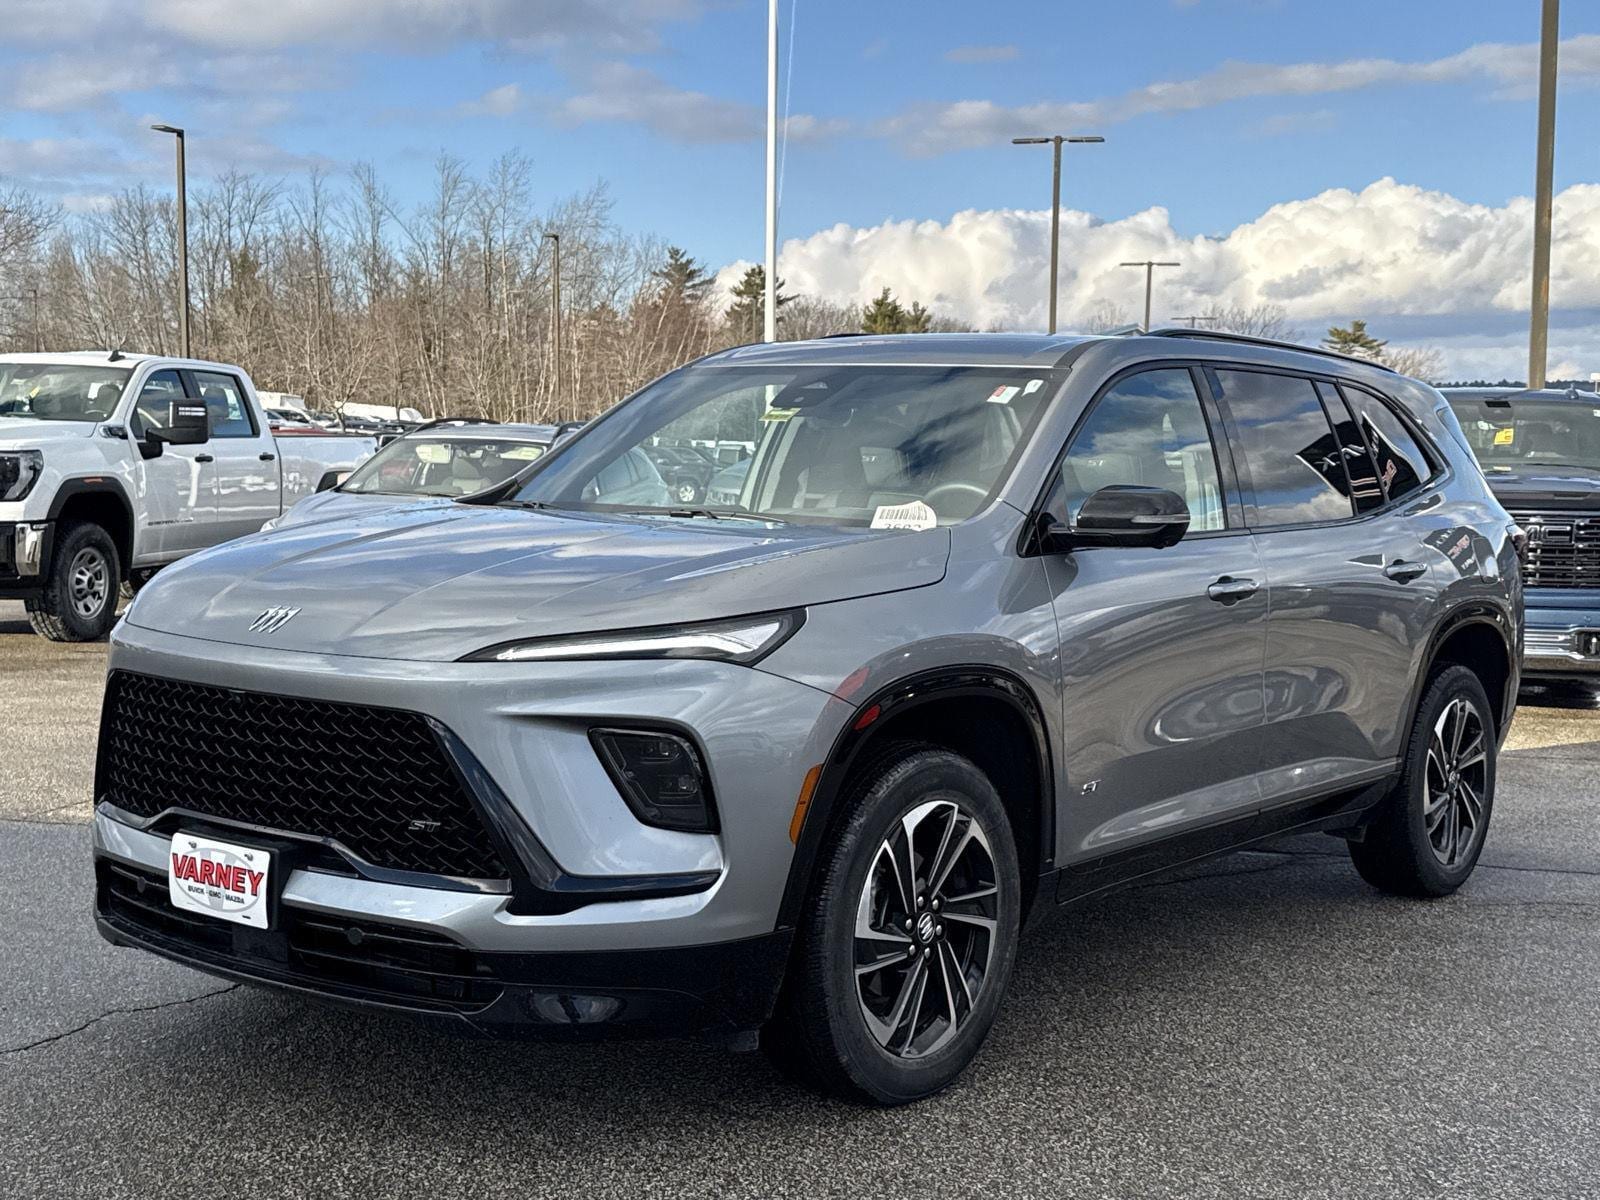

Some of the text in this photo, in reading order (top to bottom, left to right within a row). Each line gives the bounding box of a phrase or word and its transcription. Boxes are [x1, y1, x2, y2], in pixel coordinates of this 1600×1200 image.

[408, 820, 441, 832] ST
[172, 852, 265, 897] VARNEY
[188, 885, 245, 904] BUICK GMC MAZDA
